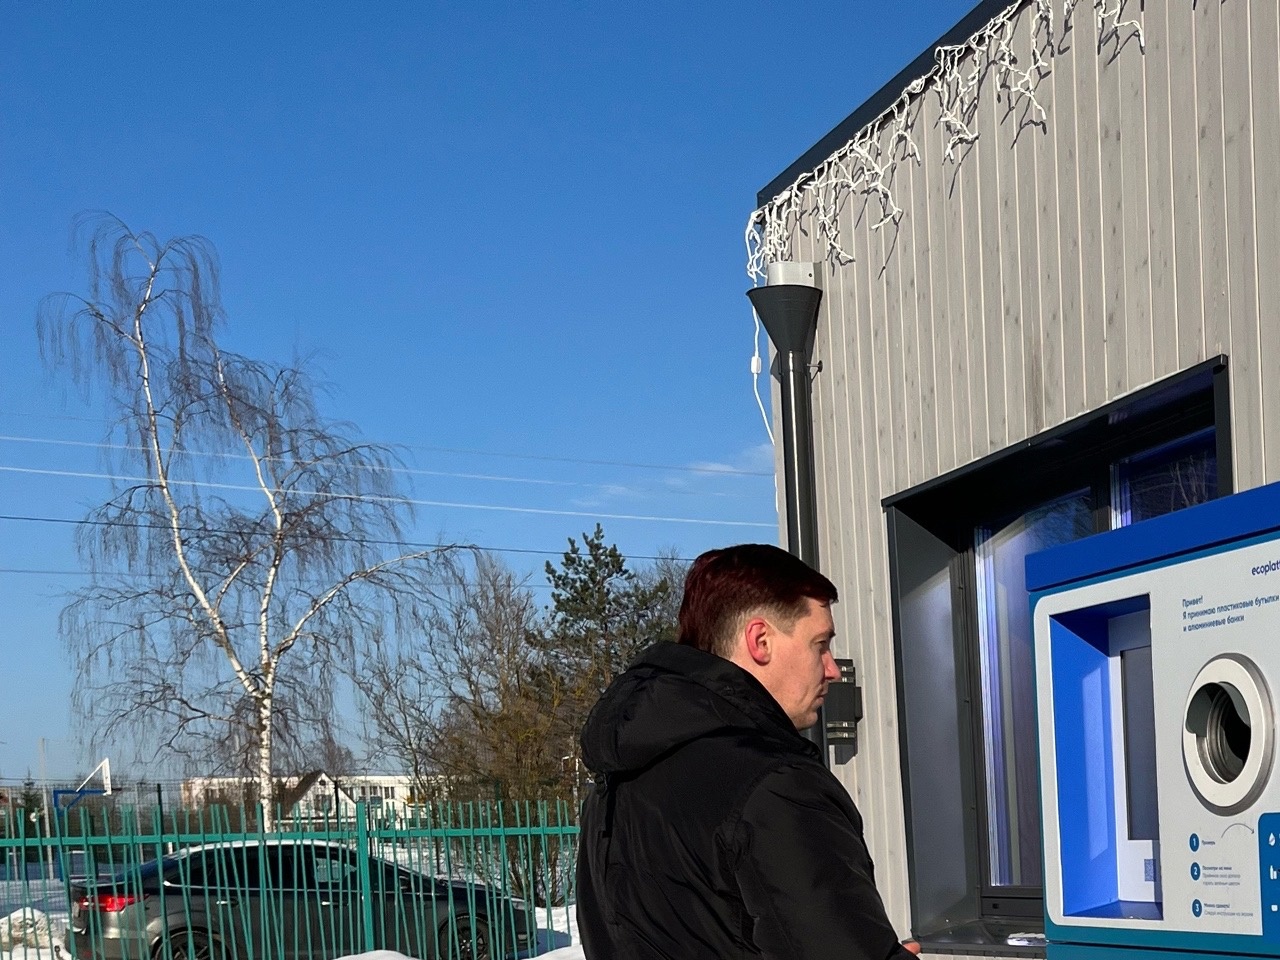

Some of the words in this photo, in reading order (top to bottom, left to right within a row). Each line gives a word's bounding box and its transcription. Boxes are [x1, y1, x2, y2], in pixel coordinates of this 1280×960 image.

[1187, 607, 1216, 619] принимаю
[1216, 600, 1254, 613] пластиковые
[1255, 595, 1280, 607] бутылки
[1188, 618, 1226, 631] алюминиевые
[1227, 615, 1245, 625] банки
